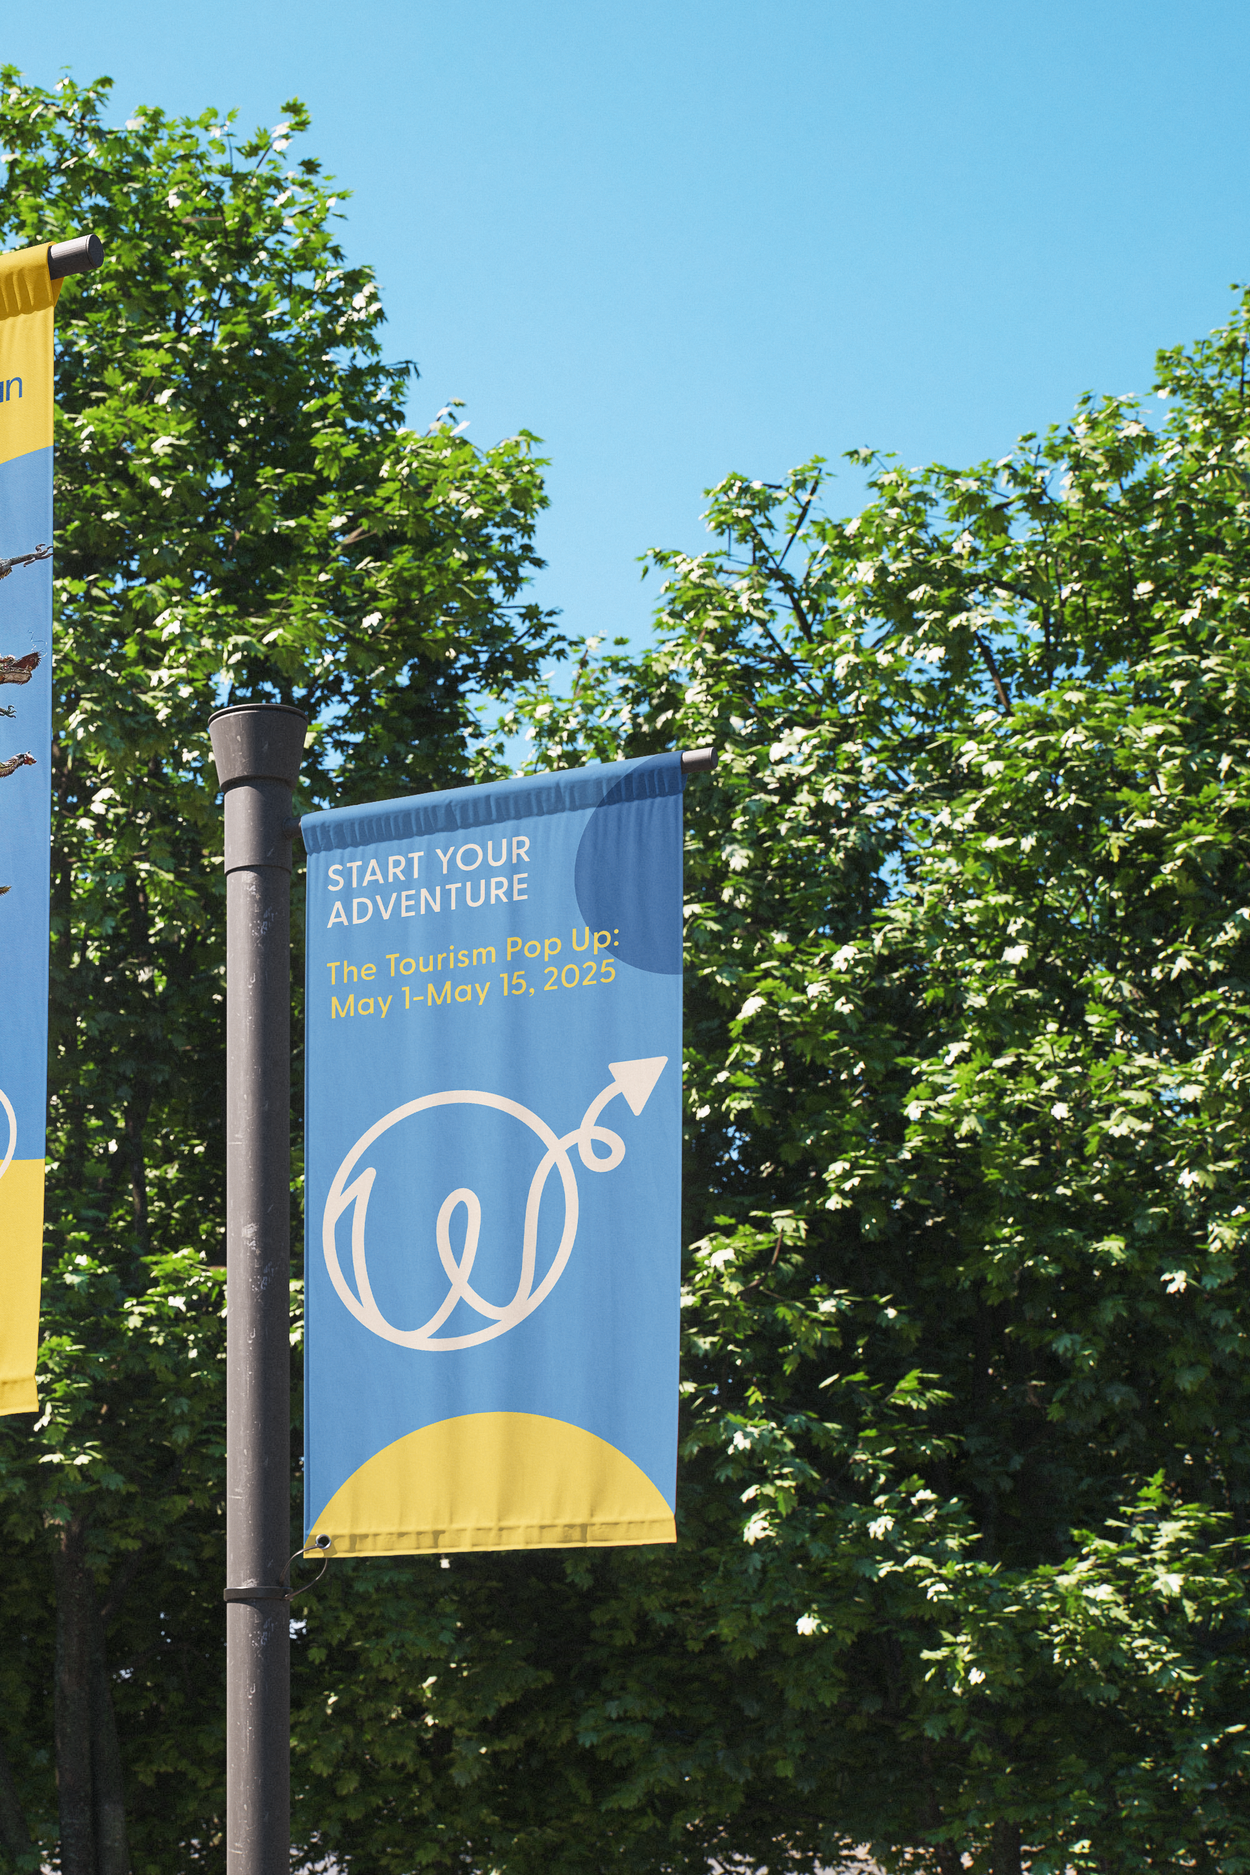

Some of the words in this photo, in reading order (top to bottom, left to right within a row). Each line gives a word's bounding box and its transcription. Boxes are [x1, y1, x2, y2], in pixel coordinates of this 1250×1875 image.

[327, 851, 424, 891] START
[435, 836, 530, 874] YOUR
[326, 873, 529, 928] ADVENTURE
[326, 961, 376, 985] The
[386, 945, 496, 977] Tourism
[507, 937, 562, 962] Pop
[572, 926, 619, 957] Up:
[331, 993, 393, 1019] May
[402, 981, 491, 1010] 1-May
[500, 971, 535, 998] 15,
[544, 959, 616, 991] 2025
